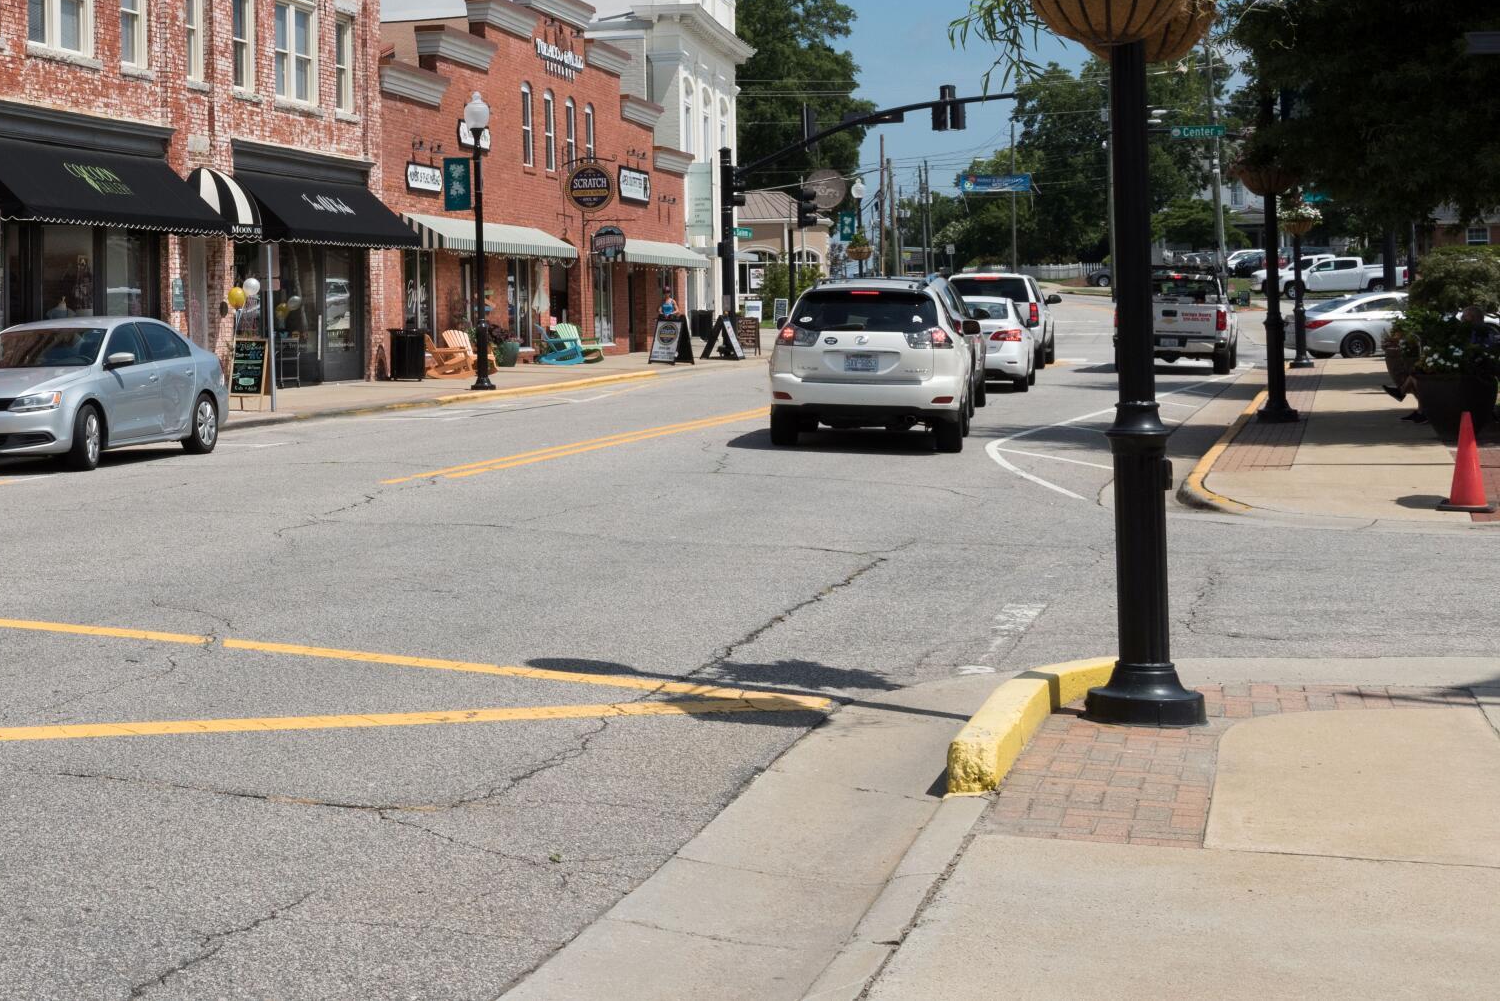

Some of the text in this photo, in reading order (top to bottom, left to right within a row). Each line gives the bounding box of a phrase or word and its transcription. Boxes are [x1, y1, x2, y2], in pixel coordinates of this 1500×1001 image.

[1183, 127, 1214, 136] Center
[63, 162, 121, 183] COCOON
[573, 177, 607, 189] SCRATCH
[231, 225, 252, 234] MOON
